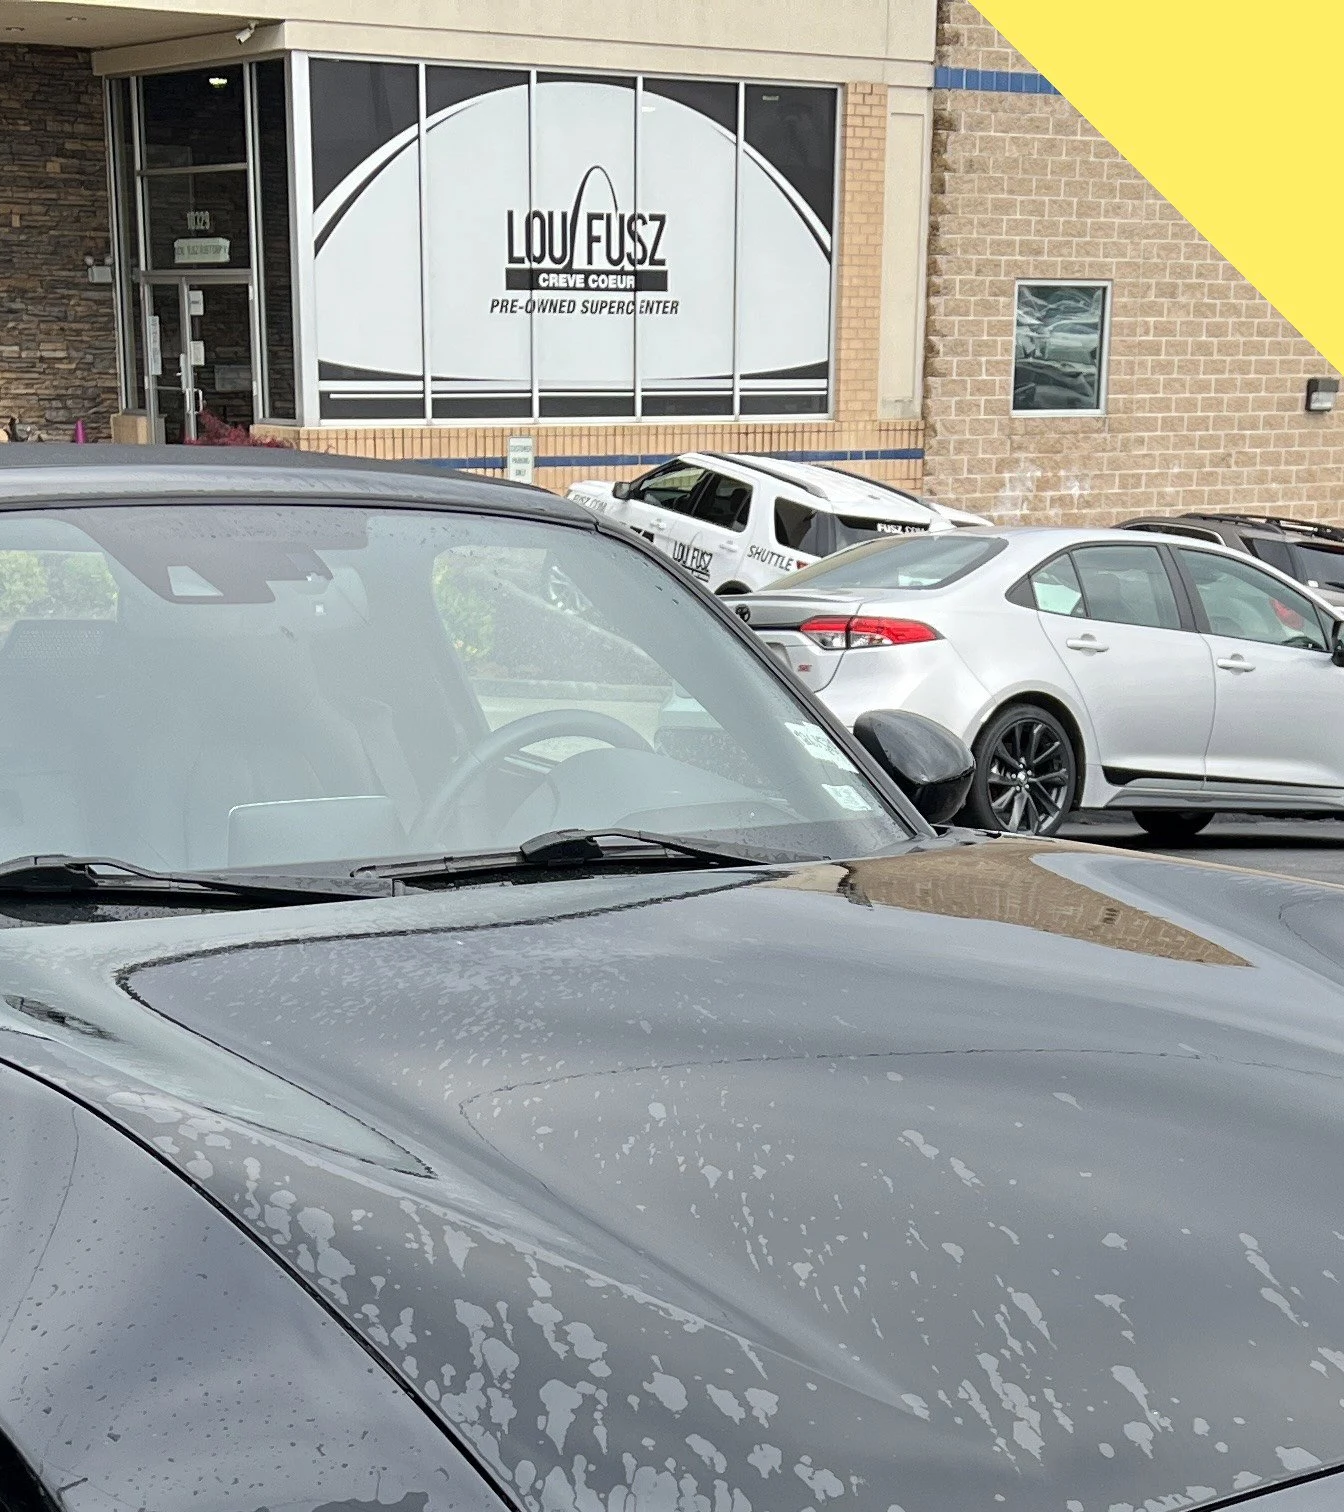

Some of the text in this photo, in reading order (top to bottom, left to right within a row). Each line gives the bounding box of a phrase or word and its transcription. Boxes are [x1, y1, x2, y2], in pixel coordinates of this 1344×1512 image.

[507, 209, 667, 267] LOU FUSZ
[538, 273, 636, 290] CREVE COEUR
[490, 298, 680, 316] PRE-OWNED SUPERCENTER
[747, 543, 794, 572] SHUTTLE
